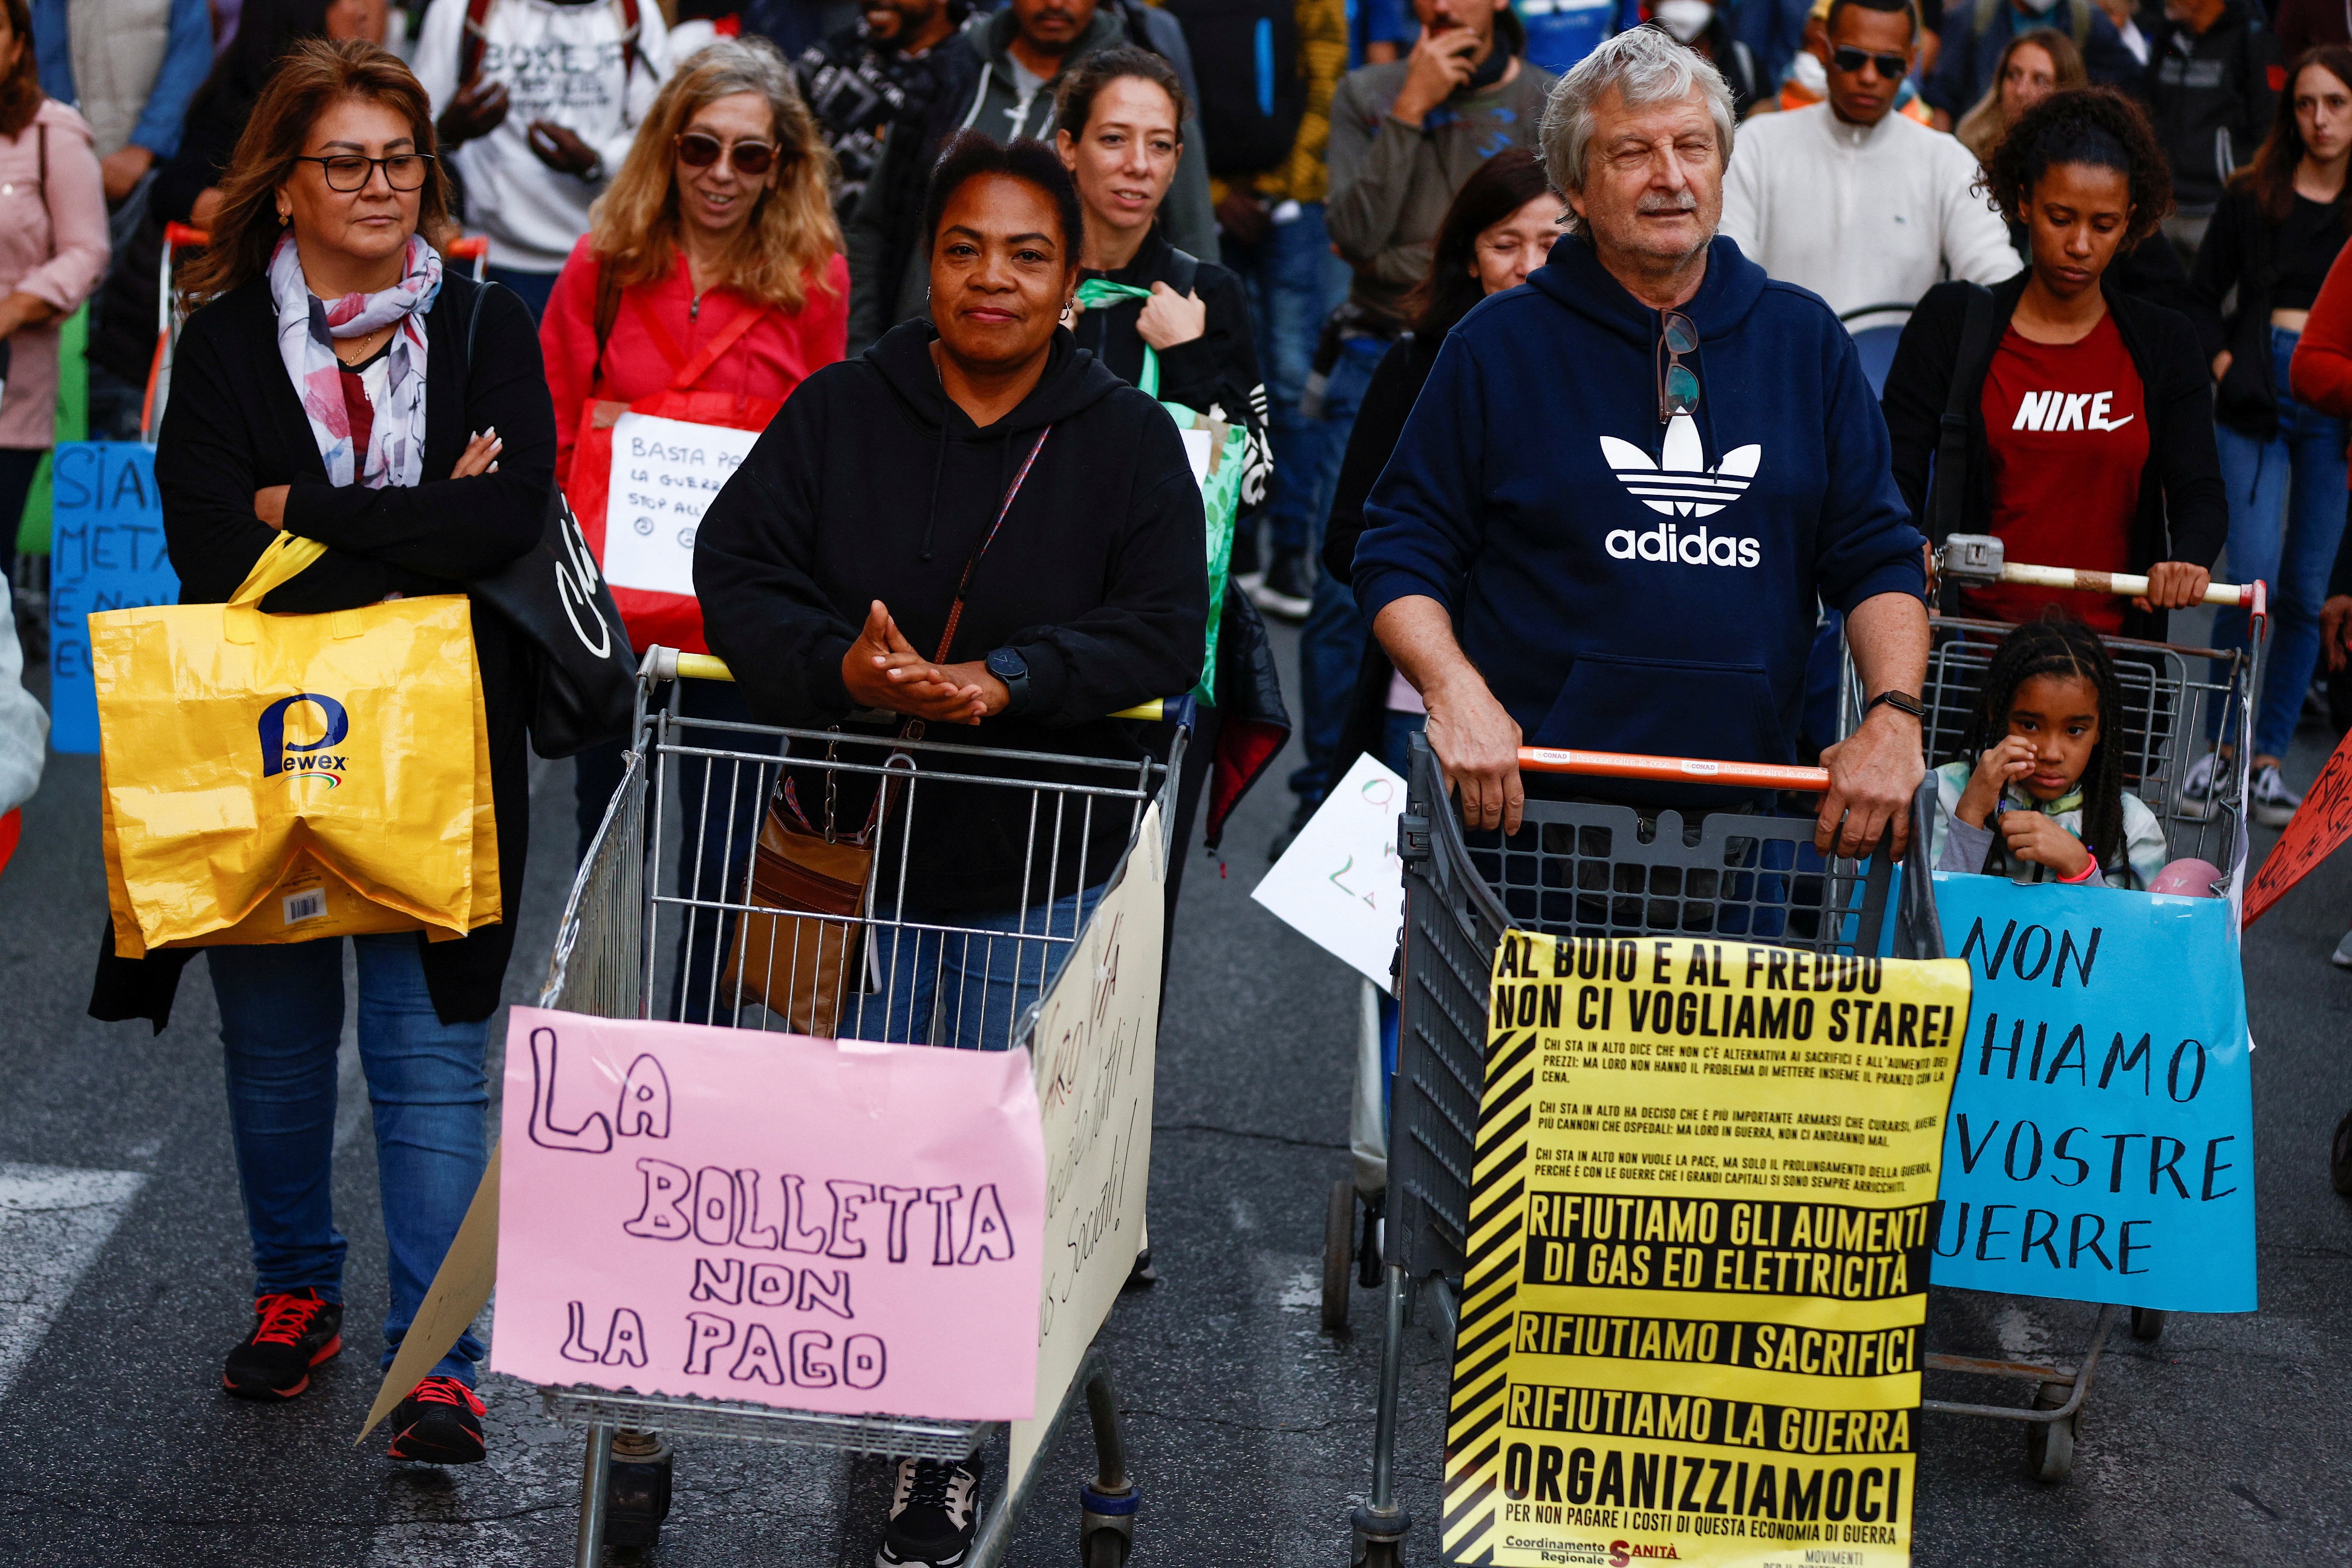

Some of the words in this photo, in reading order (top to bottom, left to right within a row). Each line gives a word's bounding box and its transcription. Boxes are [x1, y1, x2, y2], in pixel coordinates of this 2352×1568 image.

[2011, 390, 2114, 432] NIKE
[632, 436, 705, 465] BASTA
[630, 468, 649, 482] LA
[628, 492, 667, 510] STOP
[1604, 522, 1761, 569] adidas
[258, 693, 347, 778] Pewex
[1576, 753, 1612, 765] Persone
[1614, 756, 1636, 766] oltre
[1638, 757, 1647, 767] le
[1650, 760, 1670, 769] cose
[1724, 764, 1760, 776] Persone
[1762, 766, 1783, 777] oltre
[1786, 768, 1794, 778] le
[1497, 935, 1539, 978] AL
[1553, 936, 1637, 982] BUIO
[1653, 941, 1673, 984] E
[1686, 944, 1730, 988] AL
[1958, 916, 2102, 987] NON
[1495, 984, 1563, 1029] NON
[1577, 985, 1613, 1030] CI
[1629, 989, 1815, 1041] VOGLIAMO
[1828, 998, 1955, 1048] STARE!
[1543, 1055, 1578, 1067] PREZZI:
[1583, 1057, 1598, 1068] MA
[1602, 1057, 1626, 1070] LORO
[1631, 1059, 1650, 1071] NON
[1654, 1061, 1687, 1073] HANNO
[1690, 1063, 1699, 1074] IL
[1704, 1063, 1755, 1076] PROBLEMA
[1759, 1065, 1768, 1076] DI
[1772, 1065, 1815, 1078] METTERE
[1818, 1068, 1860, 1082] INSIEME
[1863, 1072, 1872, 1082] IL
[1876, 1072, 1912, 1086] PRANZO
[1933, 1071, 1945, 1083] LA
[1544, 1037, 1560, 1050] CHI
[1565, 1040, 1583, 1051] STA
[1588, 1042, 1598, 1053] IN
[1602, 1042, 1625, 1054] ALTO
[1630, 1043, 1651, 1056] DICE
[1656, 1044, 1674, 1056] CHE
[1679, 1046, 1699, 1057] NON
[1723, 1048, 1786, 1061] ALTERNATIVA
[1791, 1051, 1800, 1061] AI
[1805, 1051, 1852, 1065] SACRIFICI
[1856, 1054, 1861, 1066] E
[1957, 1013, 2206, 1103] HIAMO
[528, 1027, 671, 1154] LA
[1542, 1071, 1570, 1083] CENA.
[1538, 1117, 1554, 1129] PIÙ
[1557, 1118, 1599, 1131] CANNONI
[1602, 1120, 1621, 1132] CHE
[1624, 1122, 1673, 1134] OSPEDALI:
[1676, 1124, 1691, 1135] MA
[1694, 1125, 1719, 1136] LORO
[1722, 1126, 1731, 1136] IN
[1735, 1126, 1774, 1140] GUERRA,
[1779, 1128, 1797, 1139] NON
[1801, 1129, 1810, 1140] CI
[1813, 1130, 1864, 1145] ANDRANNO
[1540, 1100, 1556, 1113] CHI
[1560, 1103, 1578, 1114] STA
[1583, 1105, 1592, 1115] IN
[1596, 1105, 1619, 1117] ALTO
[1624, 1106, 1637, 1117] HA
[1641, 1107, 1676, 1119] DECISO
[1680, 1108, 1698, 1120] CHE
[1713, 1109, 1728, 1121] PIÙ
[1733, 1111, 1792, 1124] IMPORTANTE
[1797, 1114, 1841, 1126] ARMARSI
[1846, 1116, 1864, 1129] CHE
[1869, 1119, 1911, 1133] CURARSI,
[1536, 1148, 1552, 1160] CHI
[1556, 1149, 1573, 1161] STA
[1578, 1151, 1587, 1161] IN
[1591, 1151, 1614, 1163] ALTO
[1618, 1152, 1638, 1163] NON
[1642, 1154, 1671, 1165] VUOLE
[1676, 1155, 1687, 1166] LA
[1691, 1155, 1718, 1168] PACE,
[1723, 1157, 1738, 1168] MA
[1742, 1157, 1766, 1169] SOLO
[1770, 1159, 1778, 1170] IL
[1783, 1160, 1866, 1176] PROLUNGAMENTO
[1869, 1166, 1897, 1178] DELLA
[1901, 1163, 1931, 1177] GUERRA,
[1956, 1113, 2238, 1201] VOSTRE
[1606, 1168, 1616, 1178] LE
[1619, 1168, 1656, 1180] GUERRE
[1659, 1169, 1677, 1181] CHE
[1681, 1171, 1684, 1181] I
[1687, 1171, 1722, 1183] GRANDI
[1725, 1172, 1767, 1185] CAPITALI
[1771, 1174, 1780, 1186] SI
[1783, 1175, 1808, 1187] SONO
[1811, 1176, 1850, 1190] SEMPRE
[623, 1158, 1015, 1266] BOLLETTA
[1528, 1194, 1719, 1245] RIFIUTIAMO
[1730, 1202, 1782, 1247] GLI
[1790, 1205, 1929, 1253] AUMENTI
[690, 1258, 854, 1319] NON
[1543, 1241, 1576, 1282] DI
[1586, 1243, 1652, 1287] GAS
[1662, 1246, 1704, 1288] ED
[1714, 1246, 1908, 1298] ELETTRICITÀ
[560, 1301, 648, 1368] LA
[684, 1311, 887, 1390] PAGO
[1517, 1313, 1720, 1362] RIFIUTIAMO
[1730, 1323, 1743, 1365] I
[1753, 1324, 1916, 1376] SACRIFICI
[1509, 1384, 1713, 1442] RIFIUTIAMO
[1723, 1402, 1765, 1448] LA
[1778, 1407, 1910, 1454] GUERRA
[1504, 1442, 1899, 1523] ORGANIZZIAMOCI
[1505, 1535, 1606, 1552] Coordinamento
[1506, 1503, 1530, 1522] PER
[1536, 1505, 1562, 1524] NON
[1567, 1507, 1619, 1528] PAGARE
[1624, 1511, 1628, 1529] I
[1633, 1512, 1671, 1532] COSTI
[1676, 1515, 1690, 1533] DI
[1694, 1516, 1745, 1537] QUESTA
[1751, 1520, 1820, 1541] ECONOMIA
[1825, 1524, 1838, 1541] DI
[1843, 1524, 1896, 1545] GUERRA
[1541, 1550, 1605, 1566] Regionale
[1608, 1540, 1679, 1568] SANITÀ
[1805, 1549, 1863, 1566] MOVIMENTI
